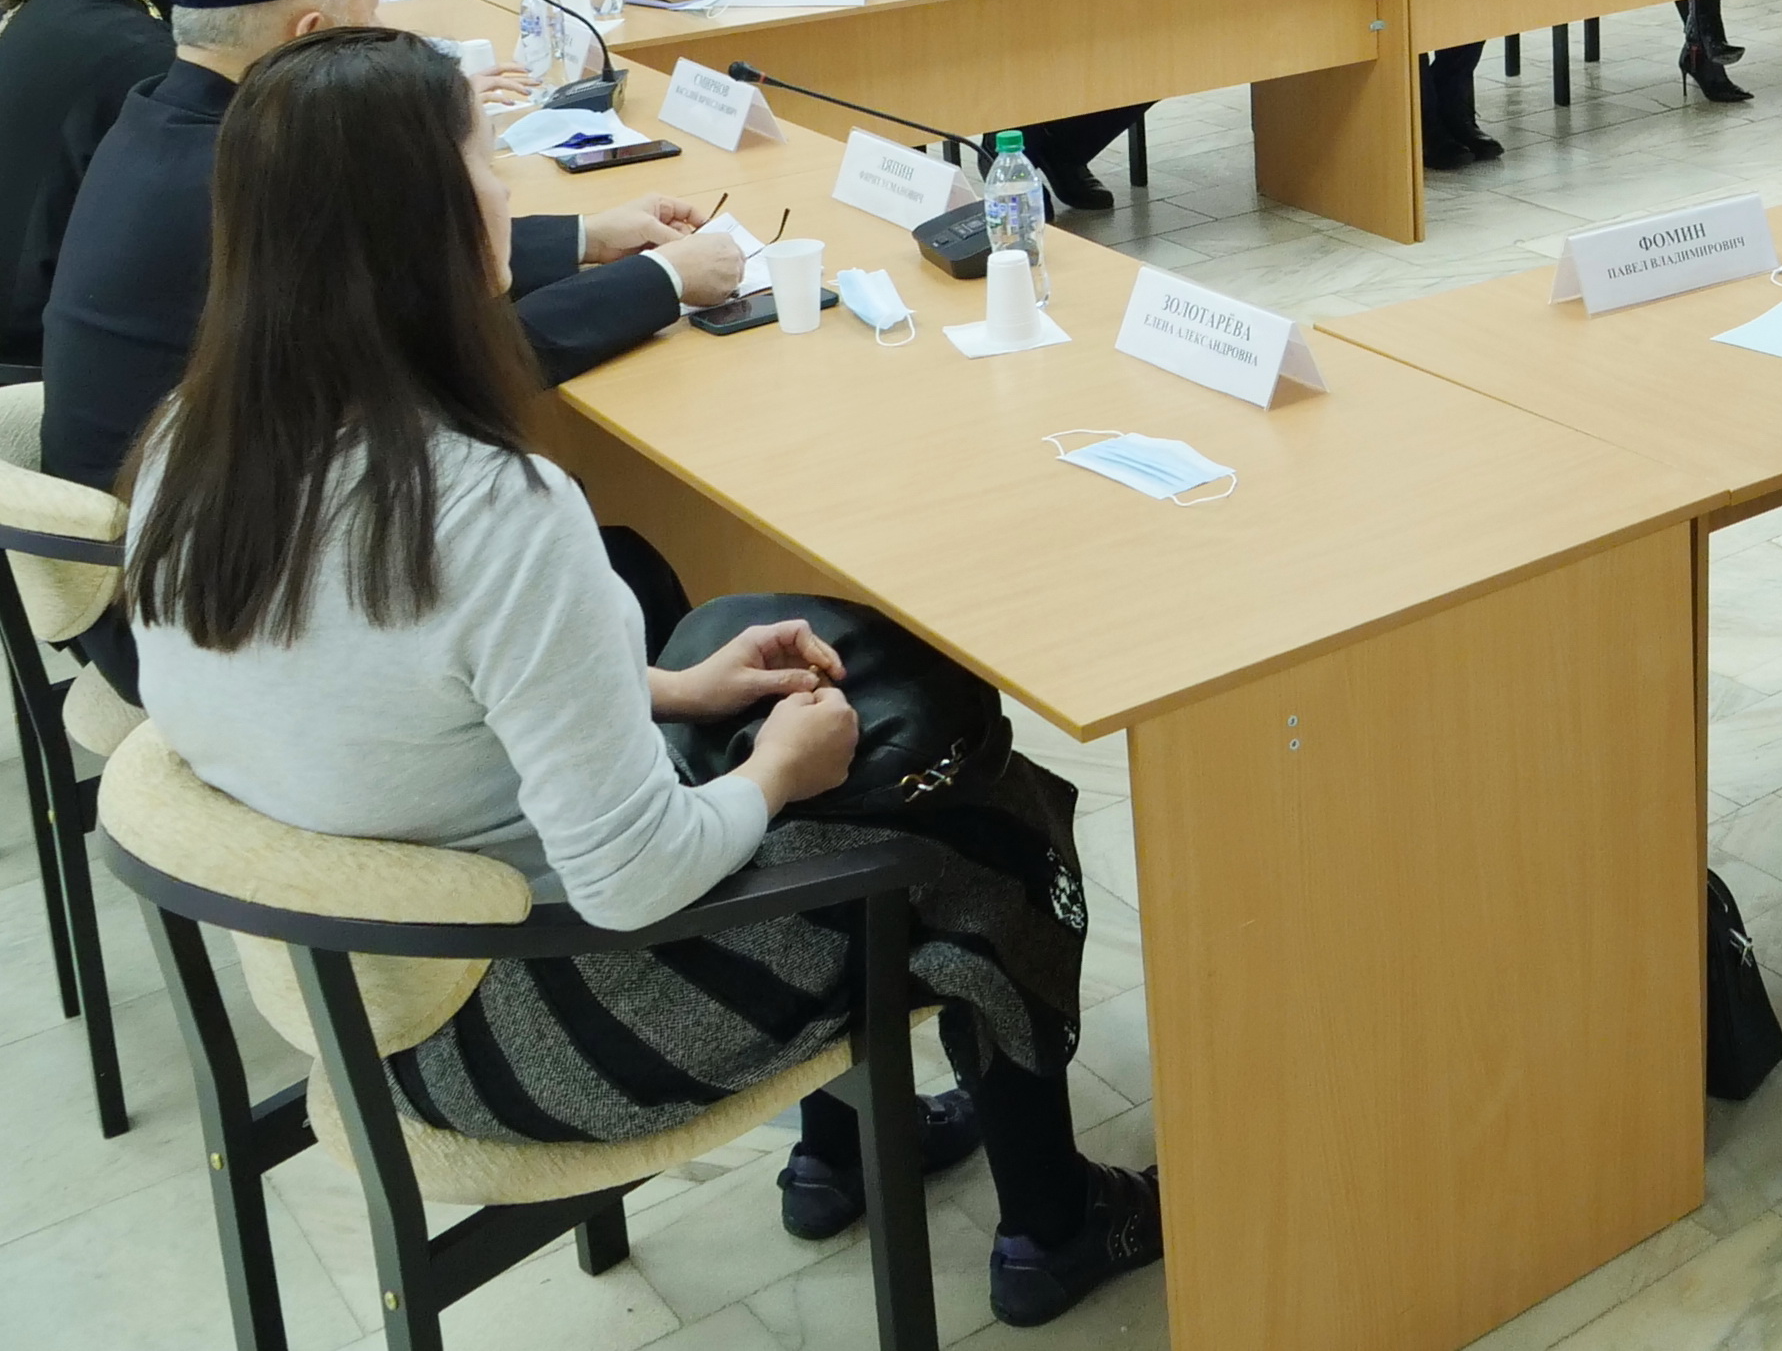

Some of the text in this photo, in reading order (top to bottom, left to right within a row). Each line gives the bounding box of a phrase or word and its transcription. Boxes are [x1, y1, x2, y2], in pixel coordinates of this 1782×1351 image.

[1606, 236, 1746, 281] ПАВЕЛ ВЛАДИМИРОВИЧ
[1638, 222, 1707, 252] ФОМИН
[1143, 313, 1259, 368] ЕЛЕНА АЛЕКСАНДРОВНА
[1161, 293, 1252, 343] ЗОЛОТАРЁВА
